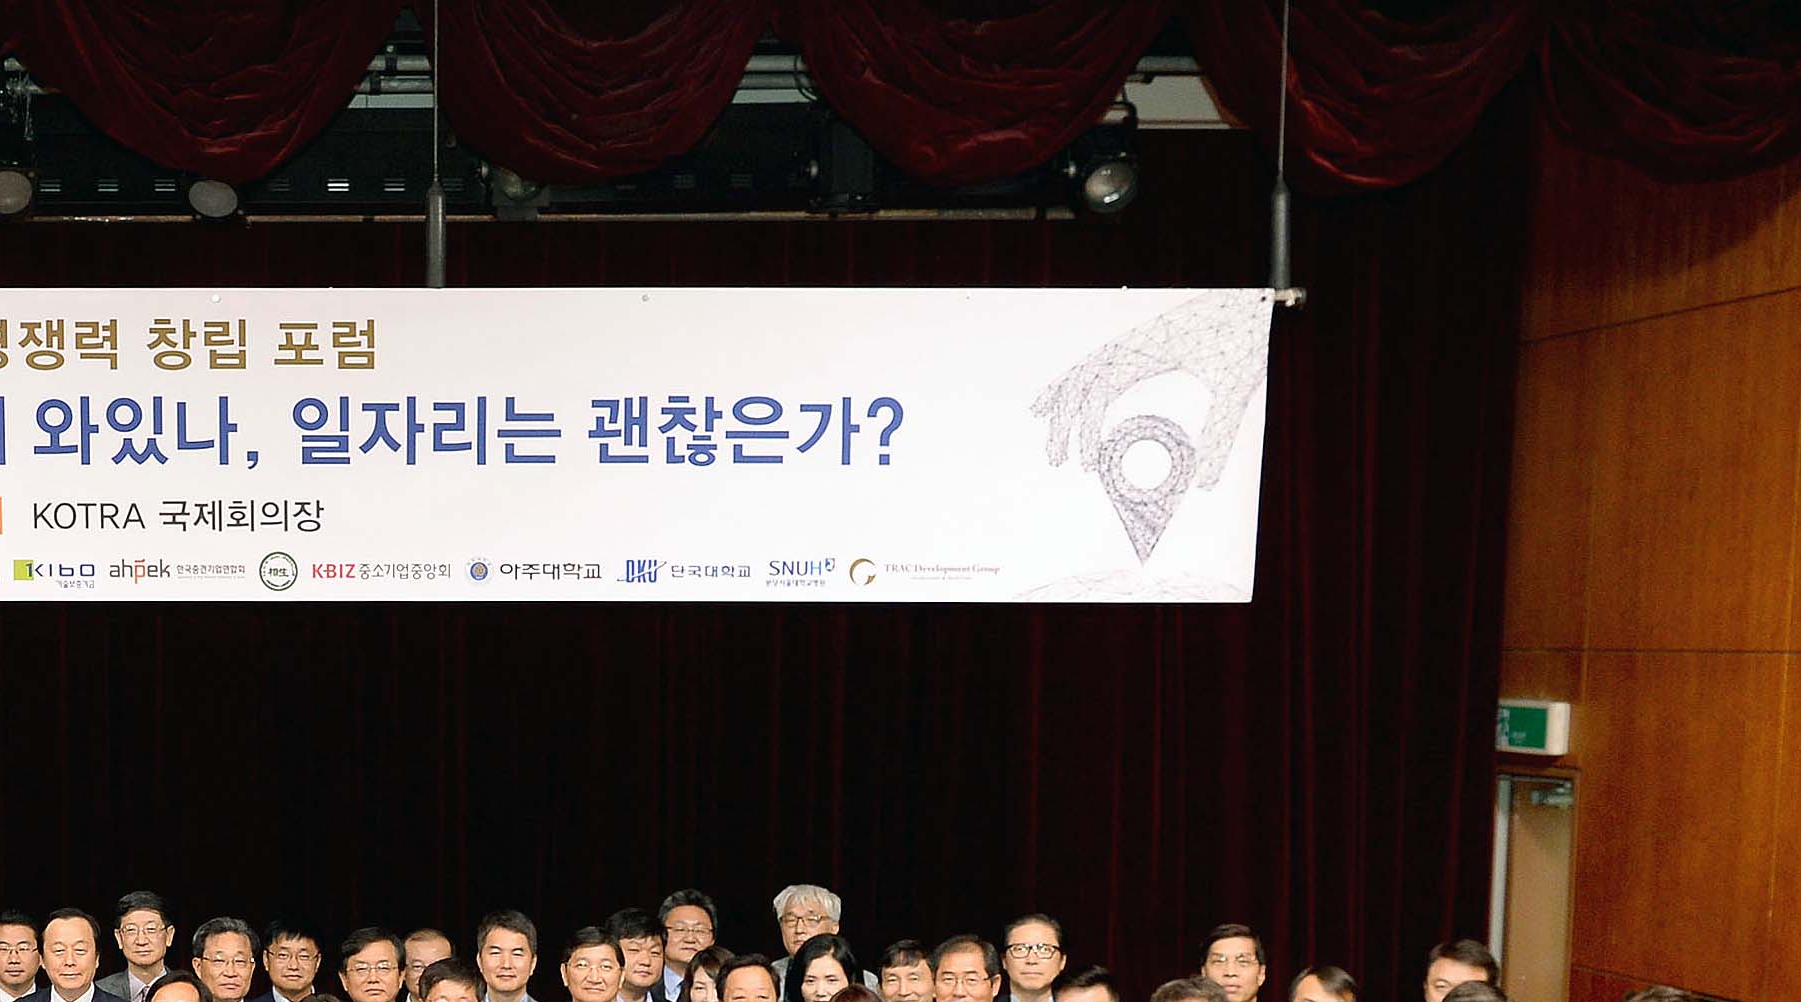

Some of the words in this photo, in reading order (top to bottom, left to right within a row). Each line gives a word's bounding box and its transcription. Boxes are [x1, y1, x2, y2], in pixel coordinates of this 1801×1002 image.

[146, 318, 247, 371] 창립
[273, 318, 376, 370] 포럼
[33, 395, 259, 471] 와있나,
[292, 395, 562, 467] 일자리는
[587, 395, 904, 467] 괜찮은가?
[33, 502, 146, 530] KOTRA
[158, 499, 325, 533] 국제회의장
[359, 562, 451, 580] 중소기업중앙회
[499, 562, 603, 581] 아주대학교
[671, 565, 751, 578] 단국대학교
[769, 560, 822, 576] SNUH
